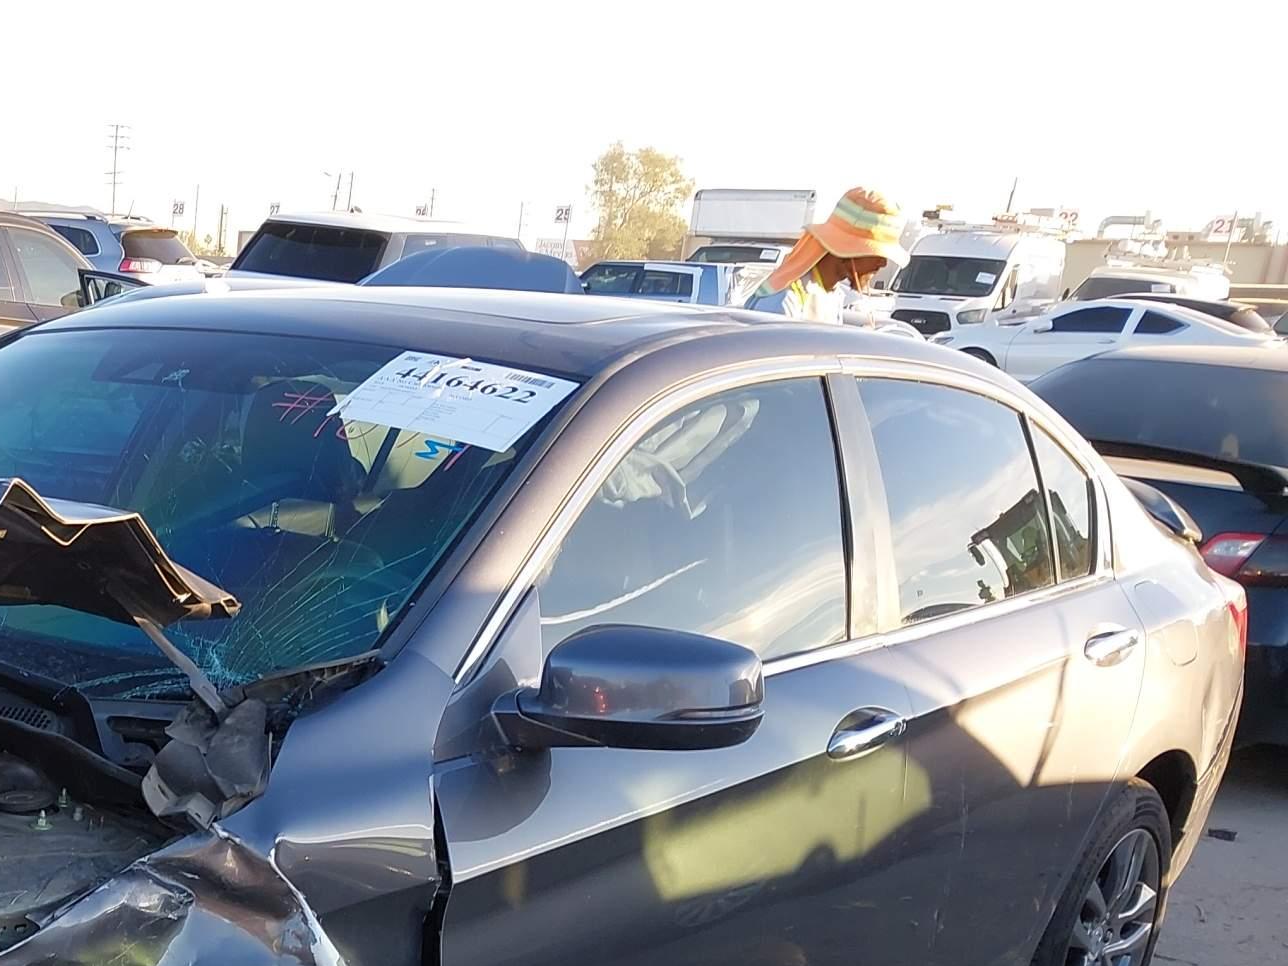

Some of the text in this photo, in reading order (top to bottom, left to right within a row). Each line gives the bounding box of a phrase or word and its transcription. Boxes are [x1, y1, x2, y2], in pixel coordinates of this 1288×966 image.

[172, 203, 185, 215] 28
[1213, 218, 1234, 233] 21
[395, 367, 537, 404] 44164622
